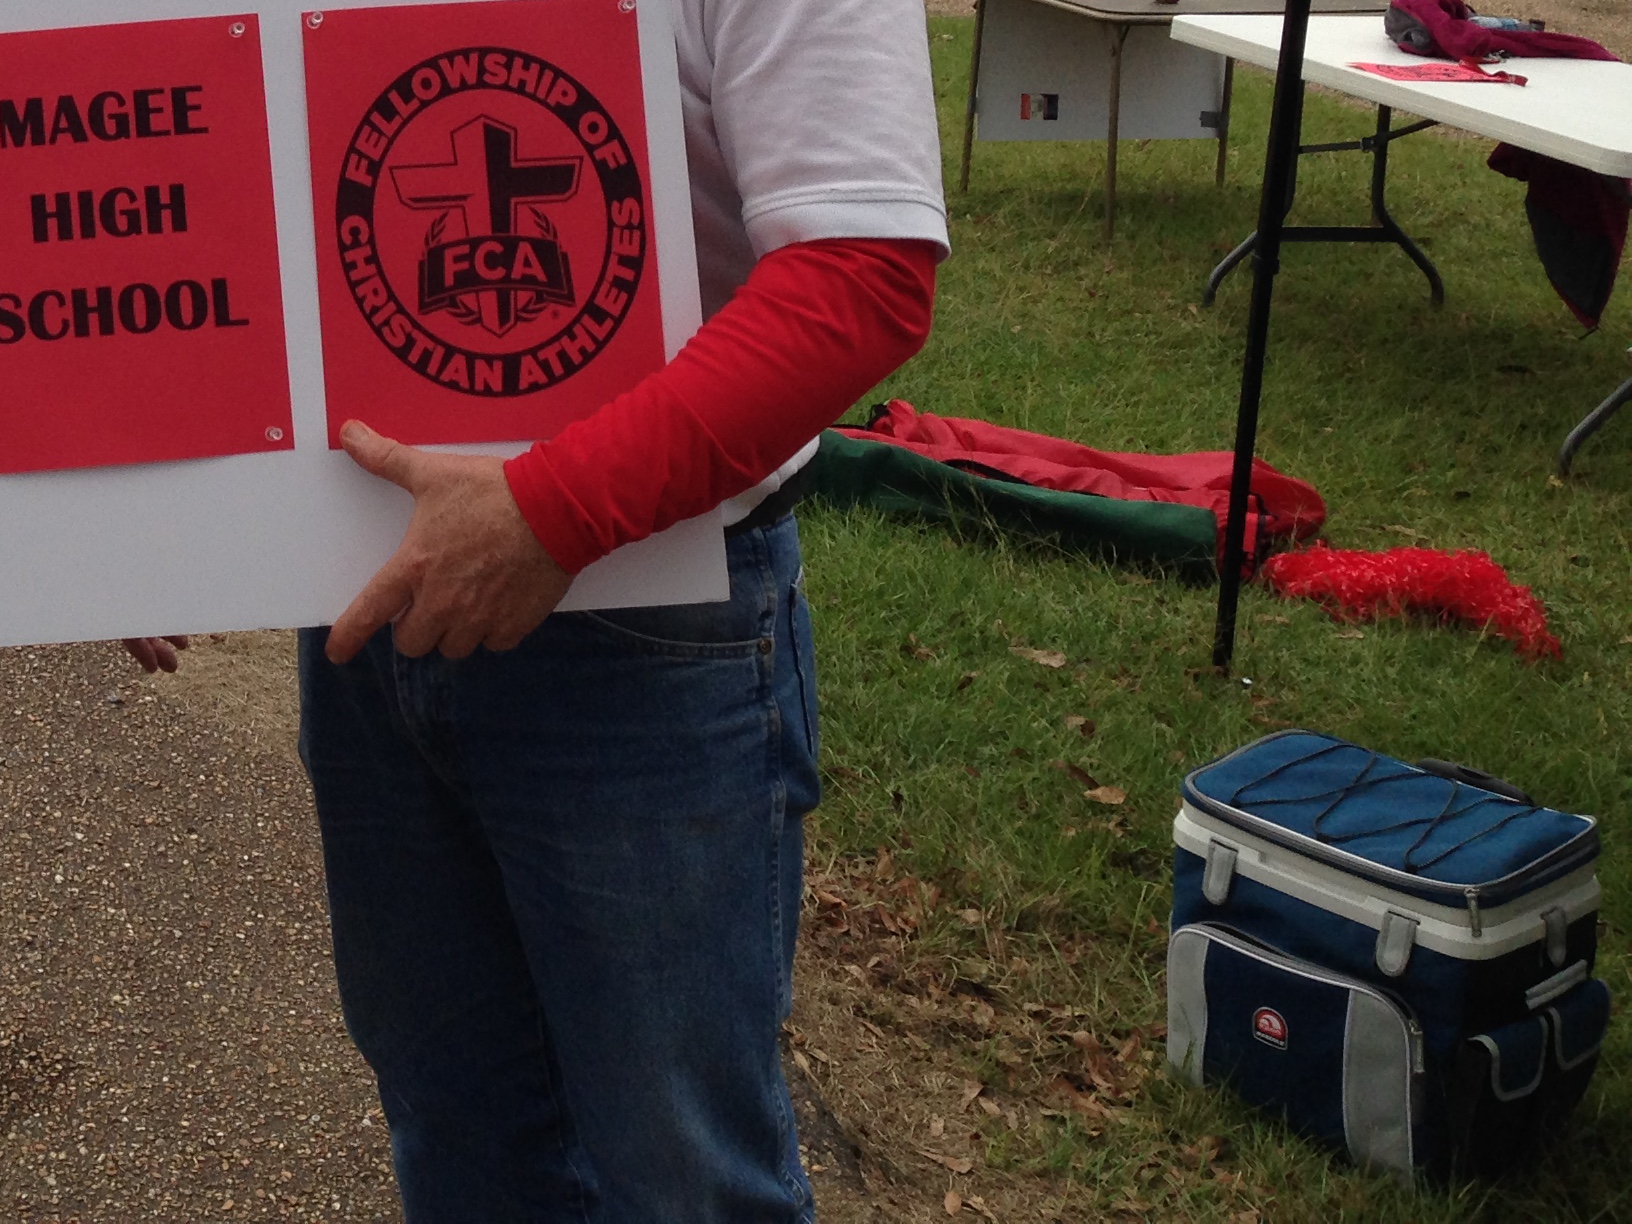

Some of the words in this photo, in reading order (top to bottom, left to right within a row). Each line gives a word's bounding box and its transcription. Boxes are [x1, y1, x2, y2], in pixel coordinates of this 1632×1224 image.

[347, 53, 578, 187] FELLOWSHIP
[579, 111, 628, 170] OF
[30, 183, 188, 243] HIGH
[341, 215, 503, 392] CHRISTIAN
[519, 196, 641, 389] ATHLETES
[444, 241, 548, 287] FCA
